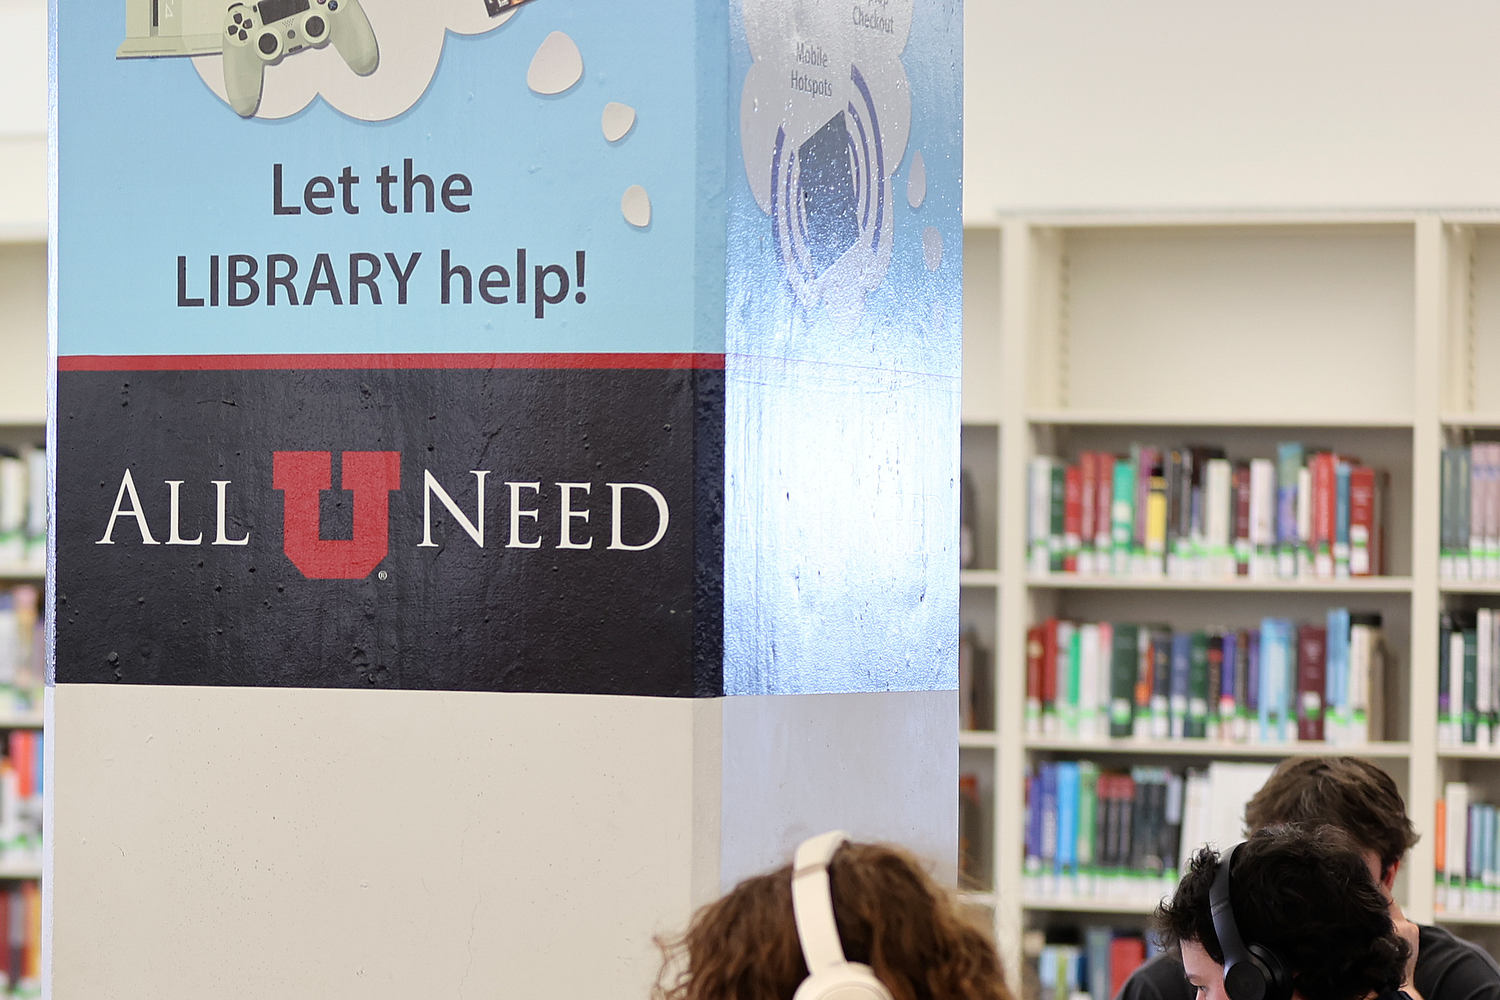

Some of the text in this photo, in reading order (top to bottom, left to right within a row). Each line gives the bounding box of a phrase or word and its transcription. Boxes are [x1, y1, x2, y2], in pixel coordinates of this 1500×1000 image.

[791, 69, 833, 98] Hotspots
[796, 42, 828, 68] Mobile
[273, 158, 473, 215] Let the
[177, 248, 587, 319] LIBRARY help!
[95, 468, 250, 546] ALL
[416, 468, 669, 551] NEED
